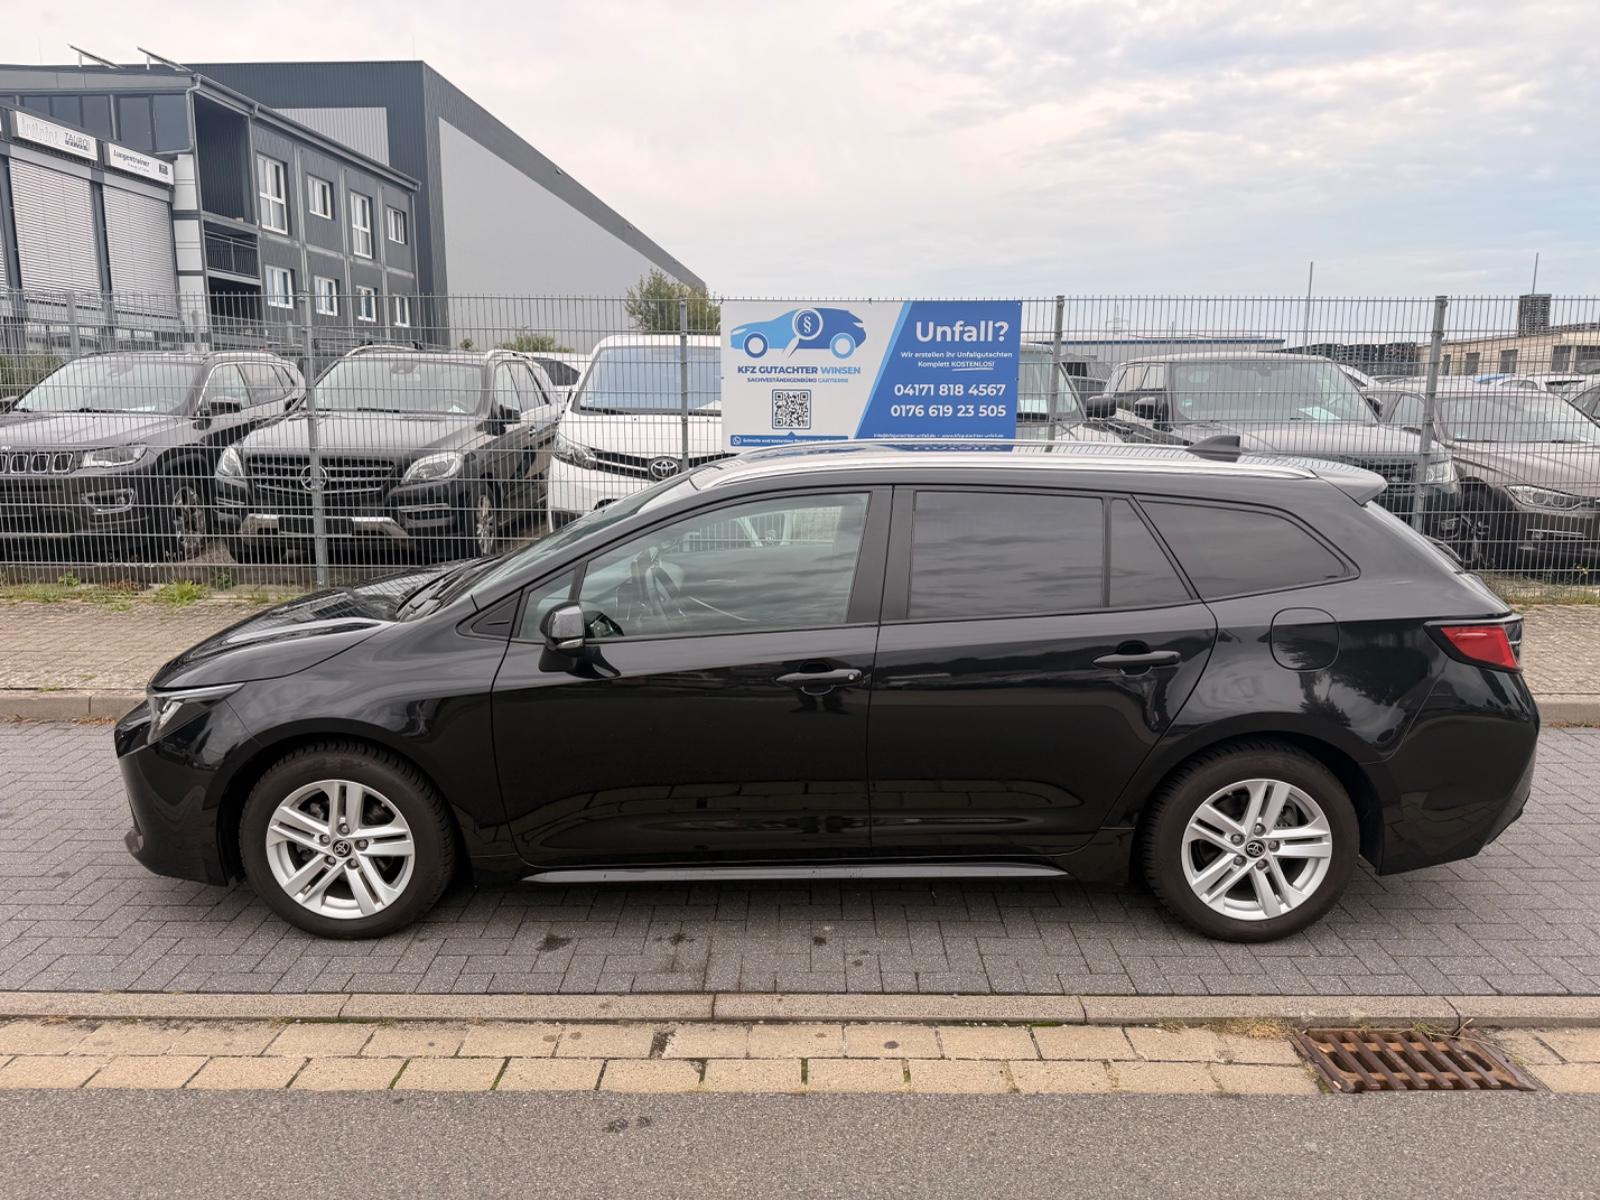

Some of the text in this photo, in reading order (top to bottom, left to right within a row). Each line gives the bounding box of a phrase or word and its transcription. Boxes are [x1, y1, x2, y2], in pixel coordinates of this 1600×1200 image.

[916, 320, 1009, 342] Unfall?
[957, 352, 1012, 360] Unfallgutachten
[918, 361, 949, 369] Komplett
[737, 366, 861, 375] KFZ GUTACHTER WINSEN
[894, 384, 1006, 396] 04171 818 4567
[890, 404, 1007, 417] 0176 619 23 505
